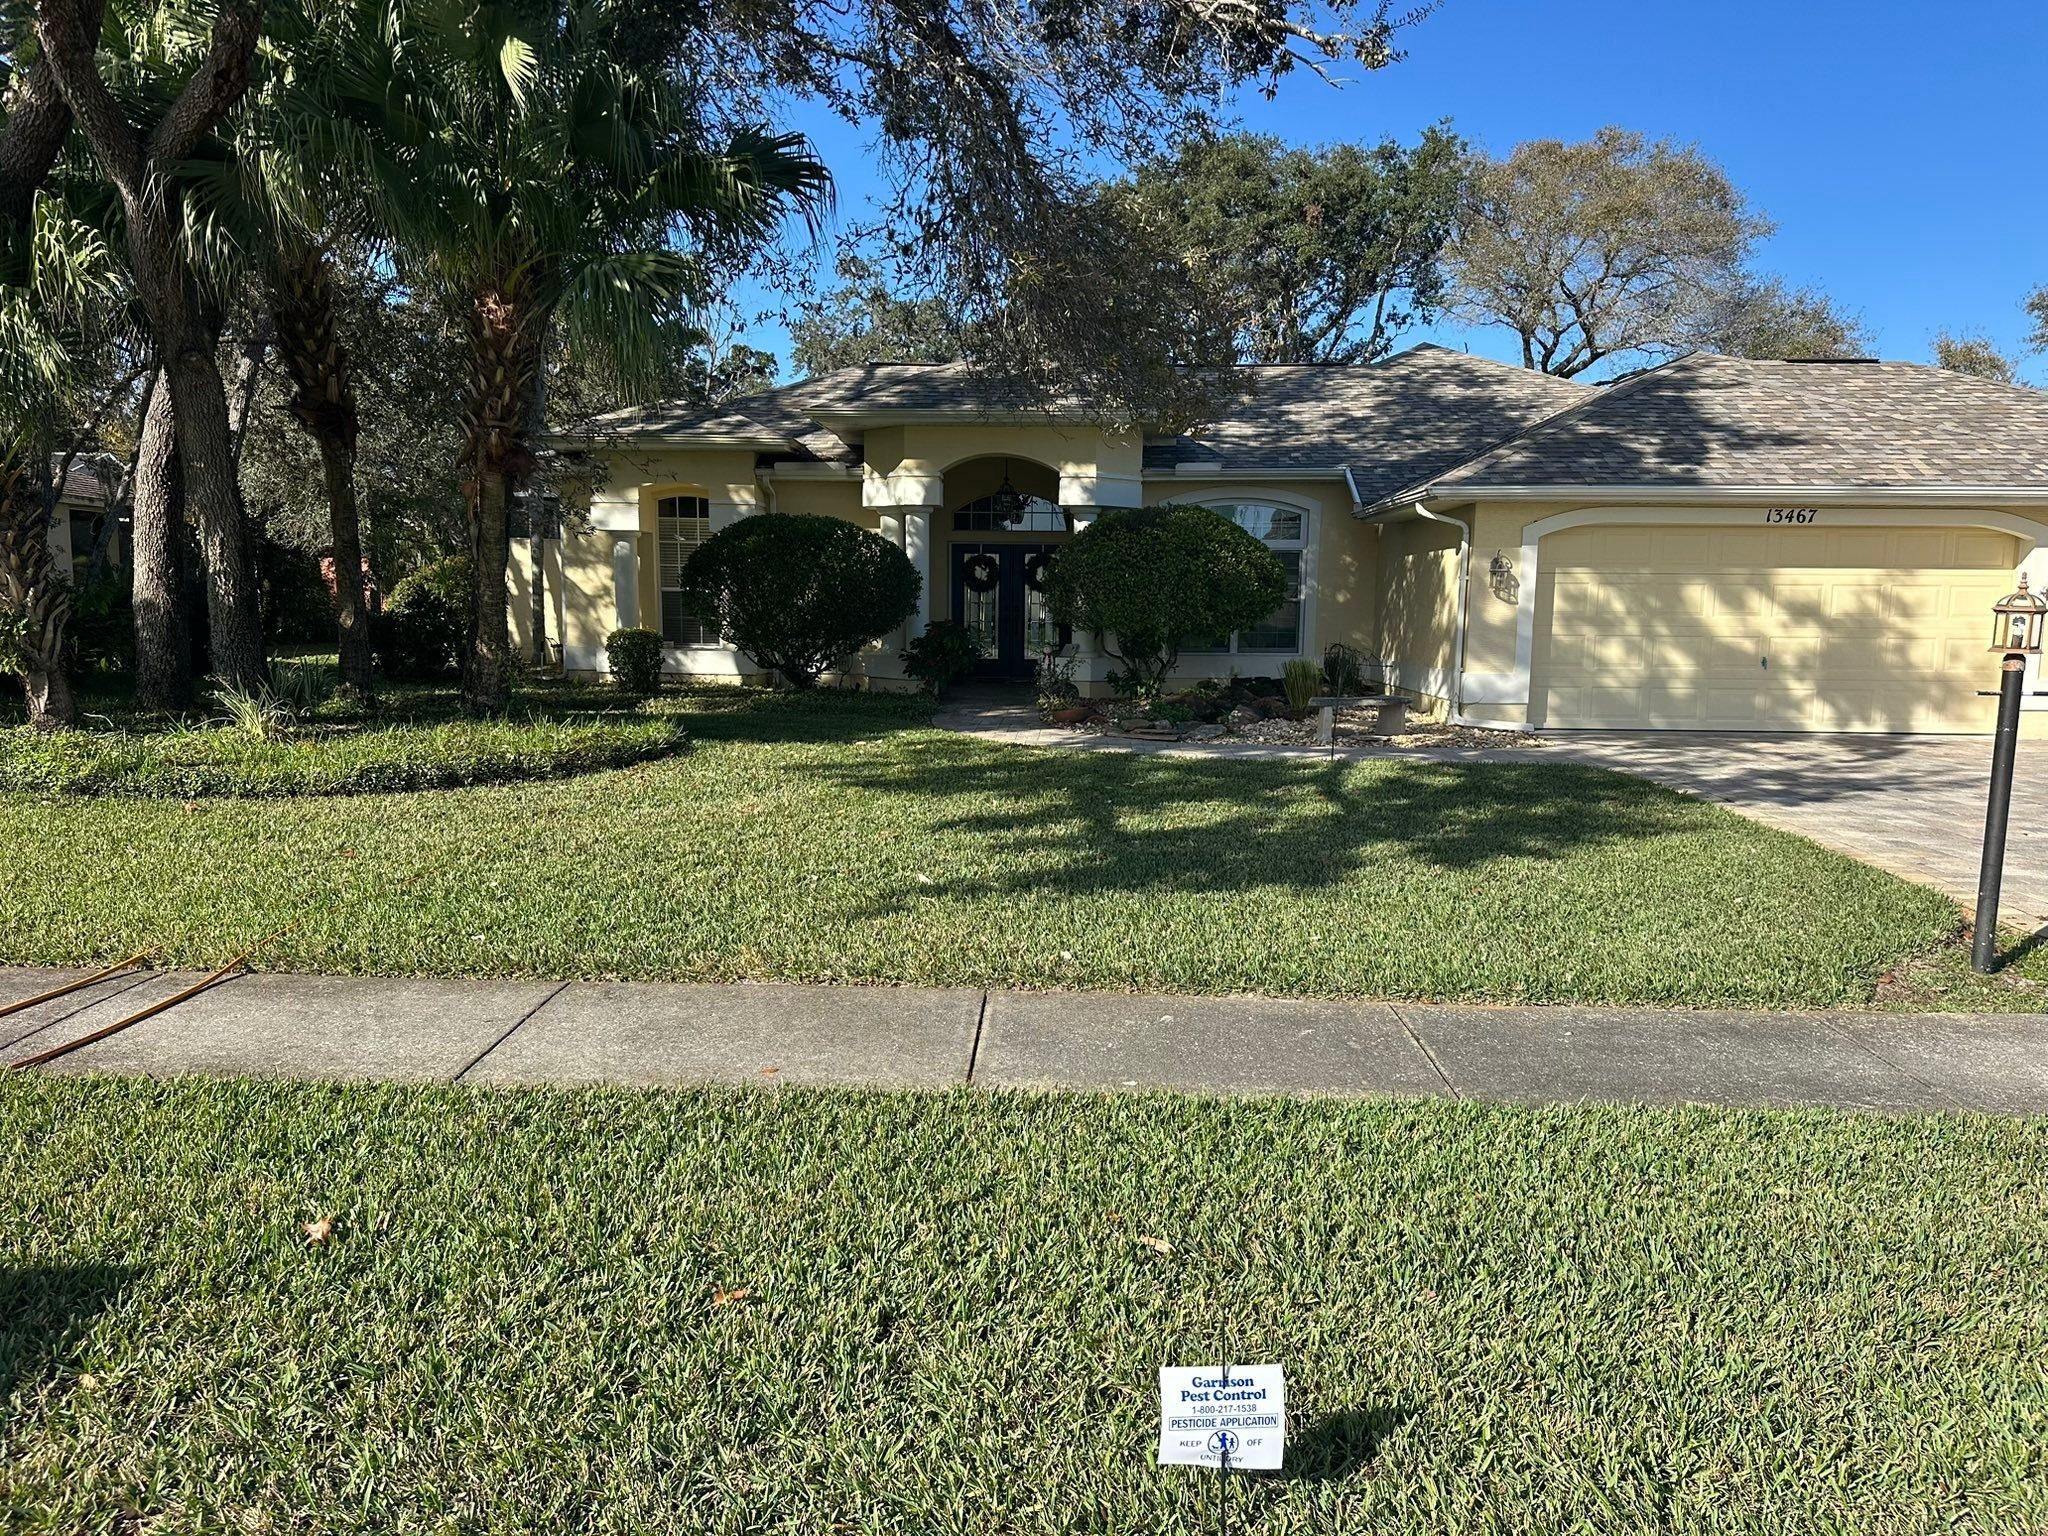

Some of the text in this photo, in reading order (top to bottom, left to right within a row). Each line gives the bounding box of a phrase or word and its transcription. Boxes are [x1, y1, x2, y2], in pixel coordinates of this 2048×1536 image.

[1766, 508, 1818, 524] 13467
[1181, 1388, 1266, 1402] Pest Control
[1191, 1404, 1257, 1414] 1-800-217-1538
[1171, 1416, 1277, 1428] PESTICIDE APPLICATION
[1246, 1438, 1263, 1447] OFF
